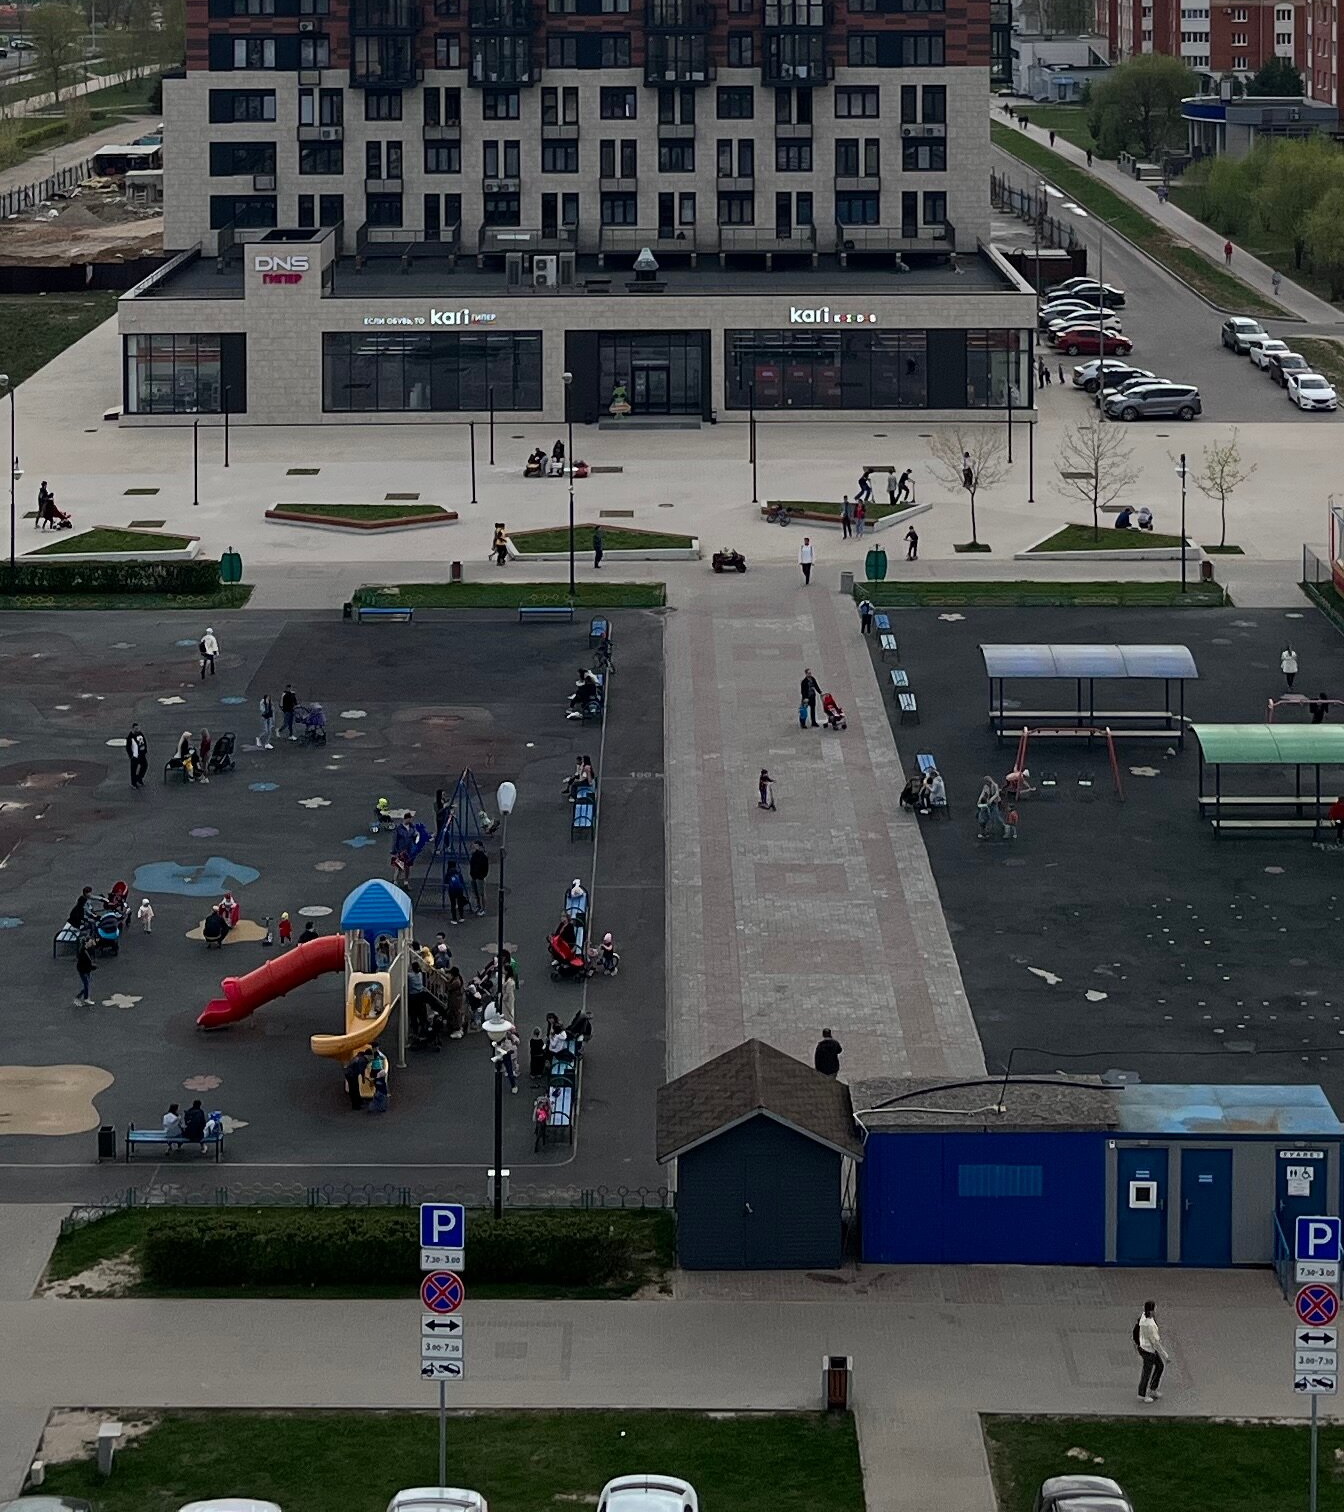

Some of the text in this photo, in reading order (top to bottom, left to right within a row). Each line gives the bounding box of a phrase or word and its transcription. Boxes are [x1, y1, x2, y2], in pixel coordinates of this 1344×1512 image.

[255, 256, 309, 271] DNS
[414, 317, 425, 325] ТО
[430, 308, 470, 325] kari
[790, 306, 830, 323] kari
[433, 1210, 456, 1243] P
[1308, 1222, 1332, 1256] P
